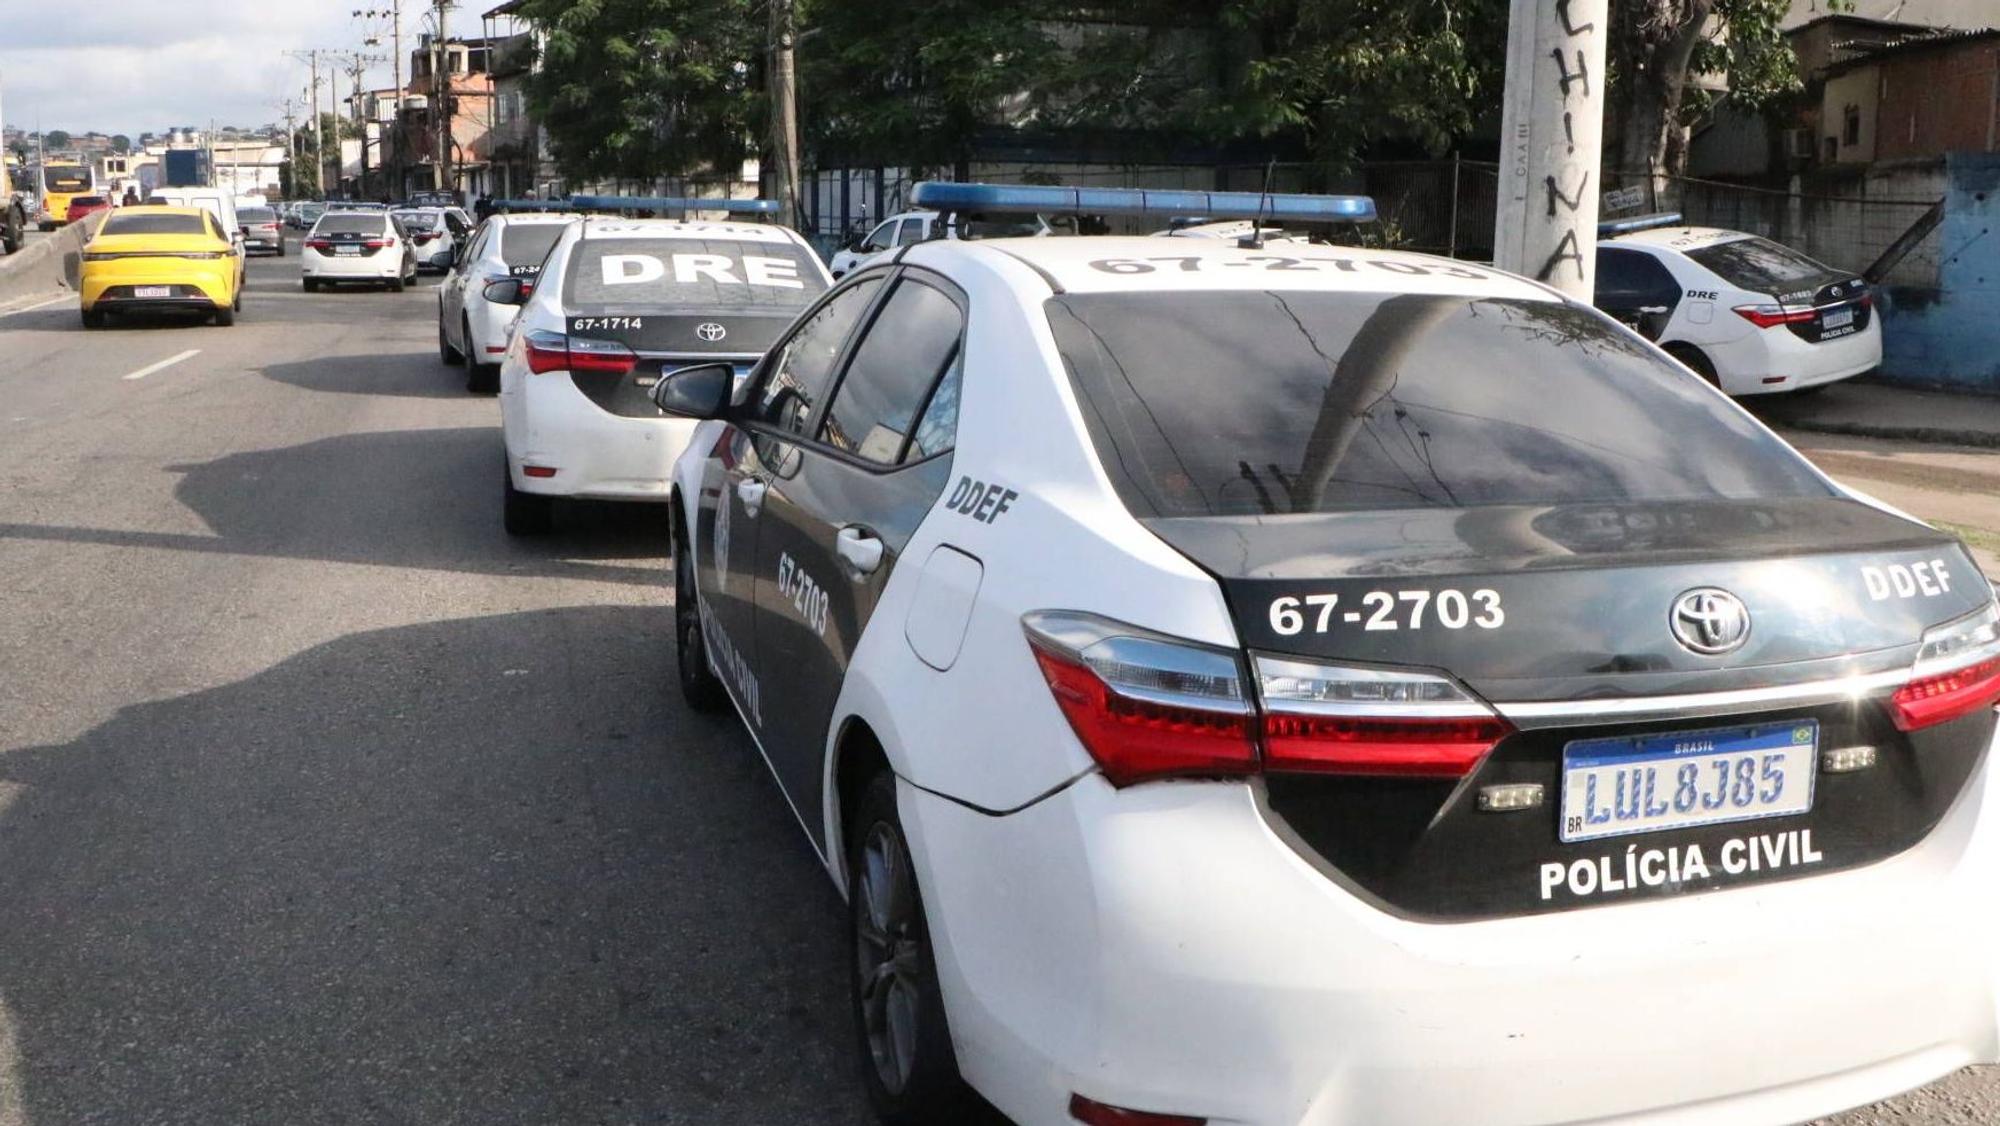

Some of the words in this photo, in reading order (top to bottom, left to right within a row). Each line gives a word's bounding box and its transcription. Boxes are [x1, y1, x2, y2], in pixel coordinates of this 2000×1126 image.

[601, 253, 804, 289] DRE
[1088, 256, 1490, 281] 67-2703
[1686, 289, 1719, 300] DRE
[573, 317, 643, 331] 67-1714
[944, 475, 1019, 525] DDEF
[778, 551, 830, 638] 67-2703
[1860, 558, 1952, 601] DDEF
[1268, 588, 1506, 637] 67-2703
[1674, 740, 1714, 755] BRASIL
[1584, 753, 1786, 826] LUL8J85
[1567, 815, 1583, 834] BR
[1540, 843, 1711, 901] POLÍCIA
[1720, 828, 1824, 876] CIVIL
